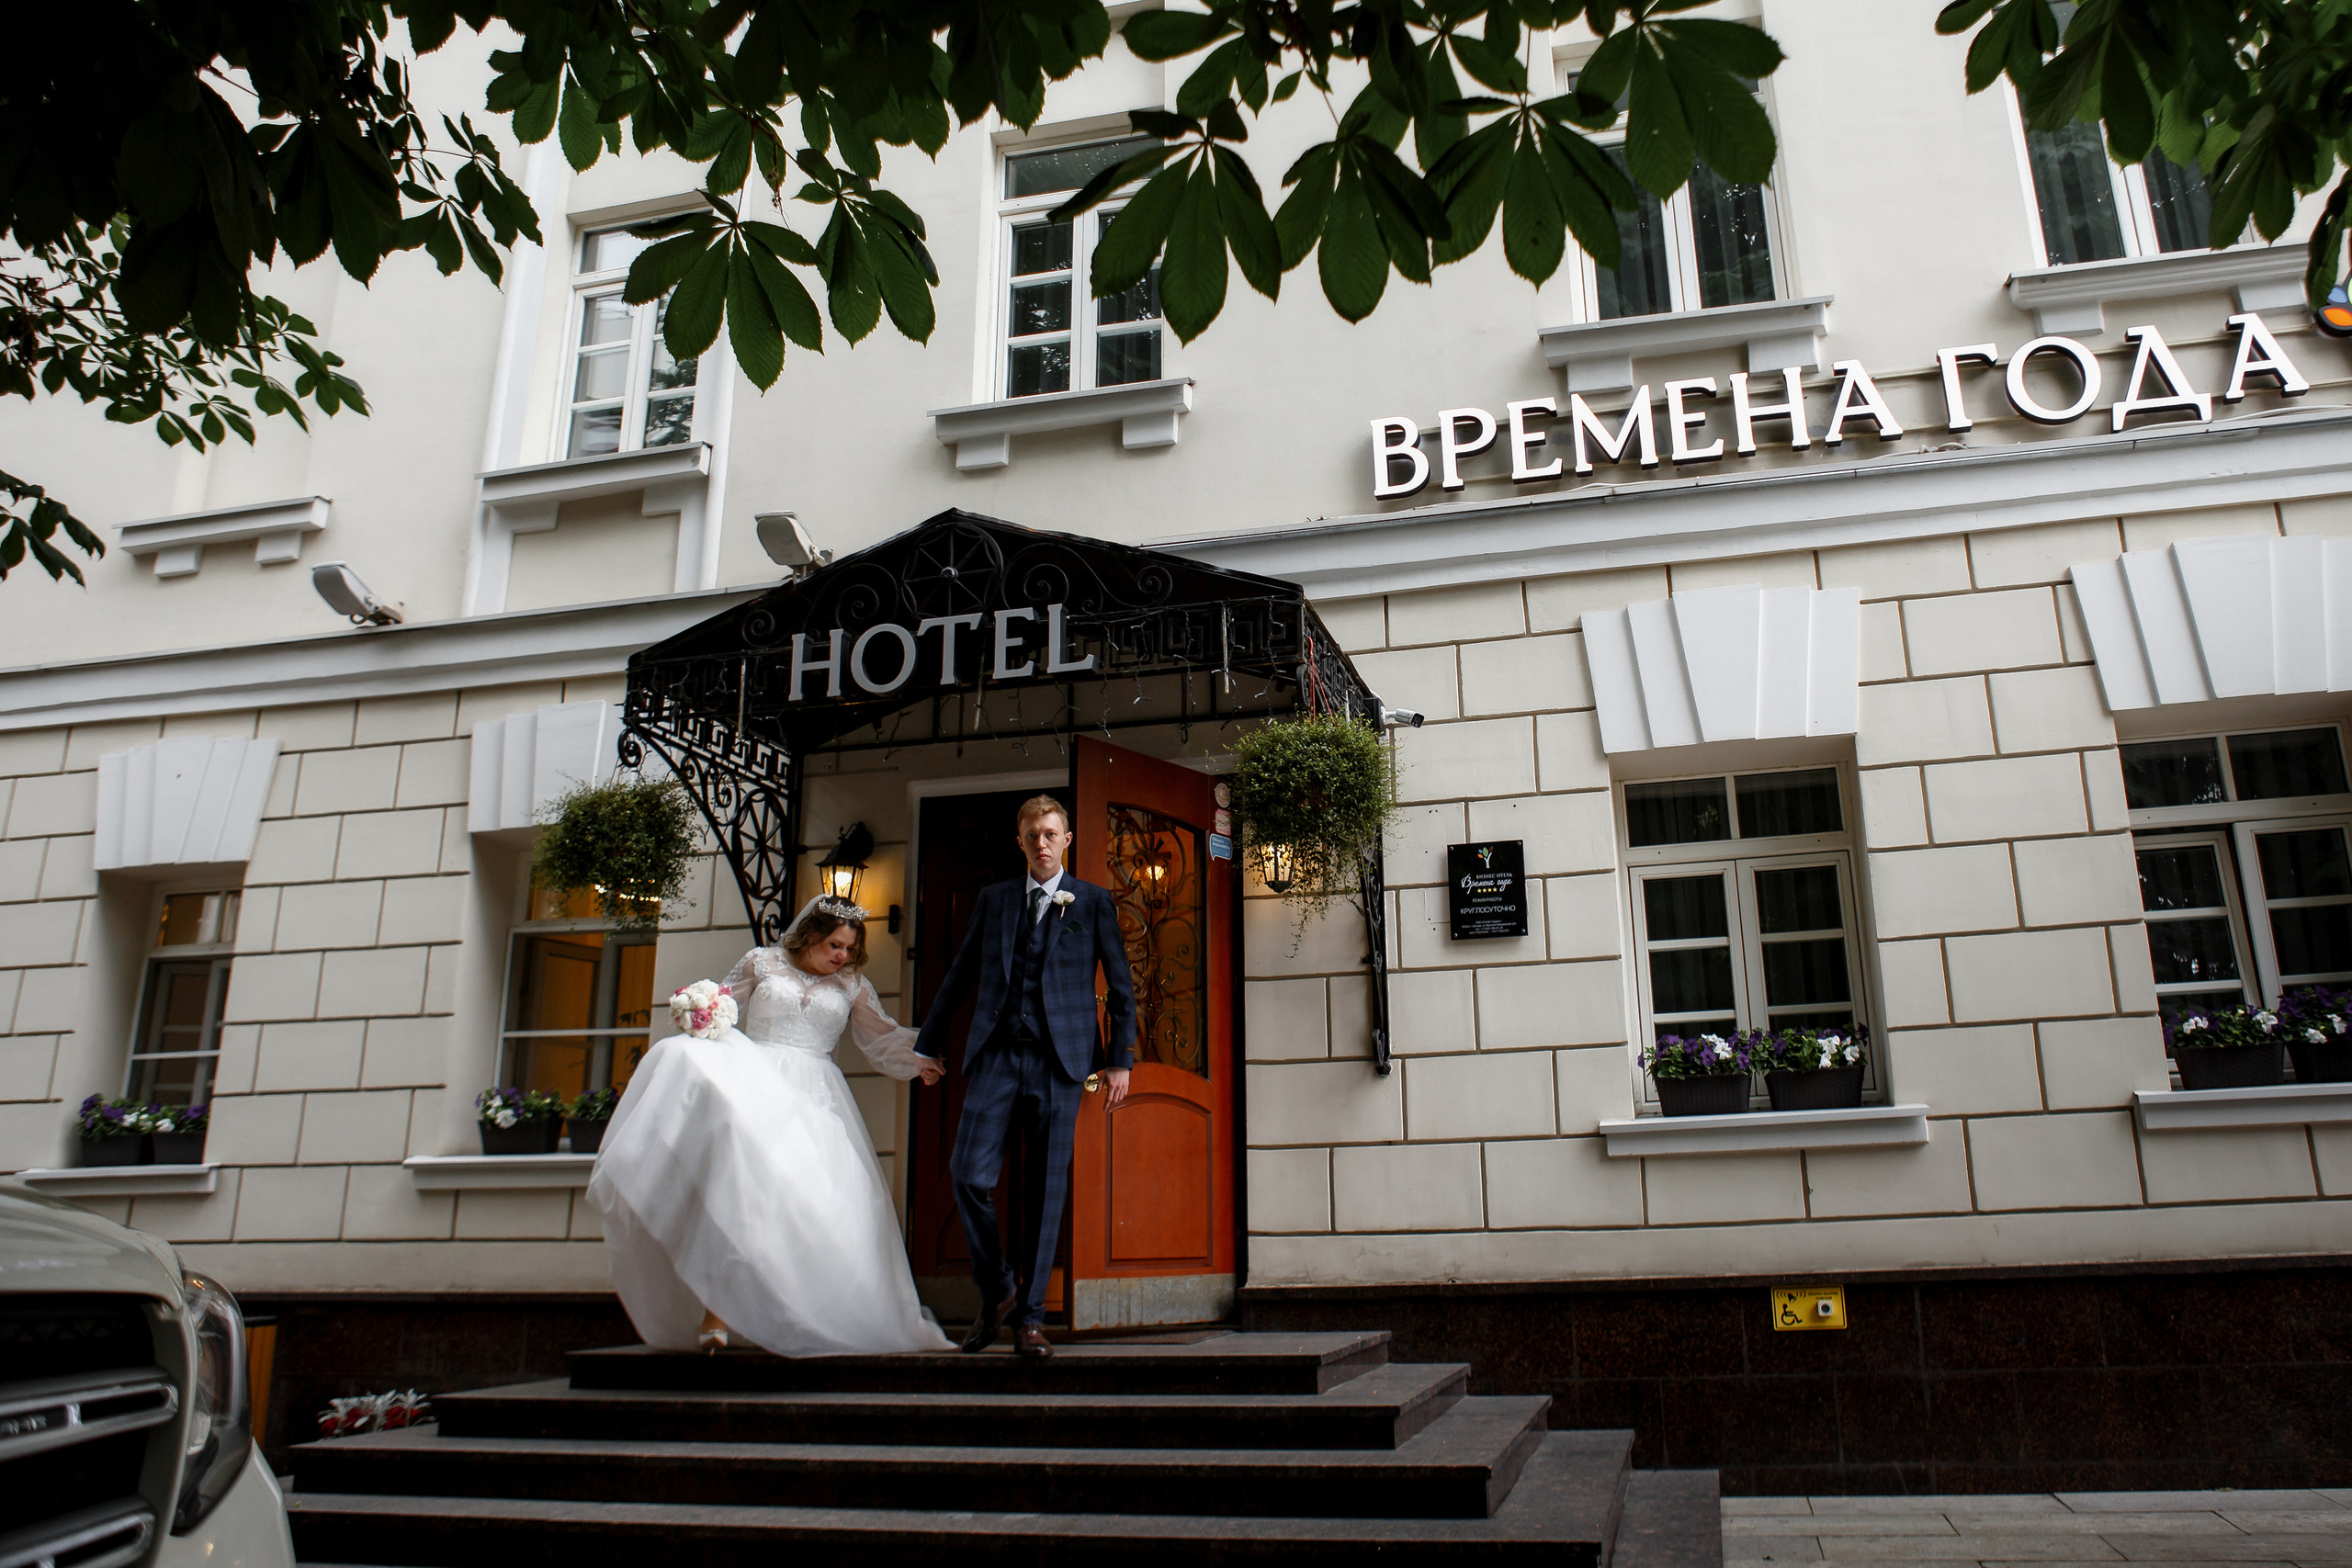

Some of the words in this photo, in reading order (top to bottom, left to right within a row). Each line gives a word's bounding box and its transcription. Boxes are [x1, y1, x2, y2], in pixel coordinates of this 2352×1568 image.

[1370, 359, 1903, 502] ВРЕМЕНА
[1936, 312, 2310, 434] ГОДА
[788, 603, 1098, 702] HOTEL
[1460, 905, 1516, 914] КРУГЛОСУТОЧНО
[1461, 874, 1495, 894] Времена
[1497, 879, 1512, 892] года
